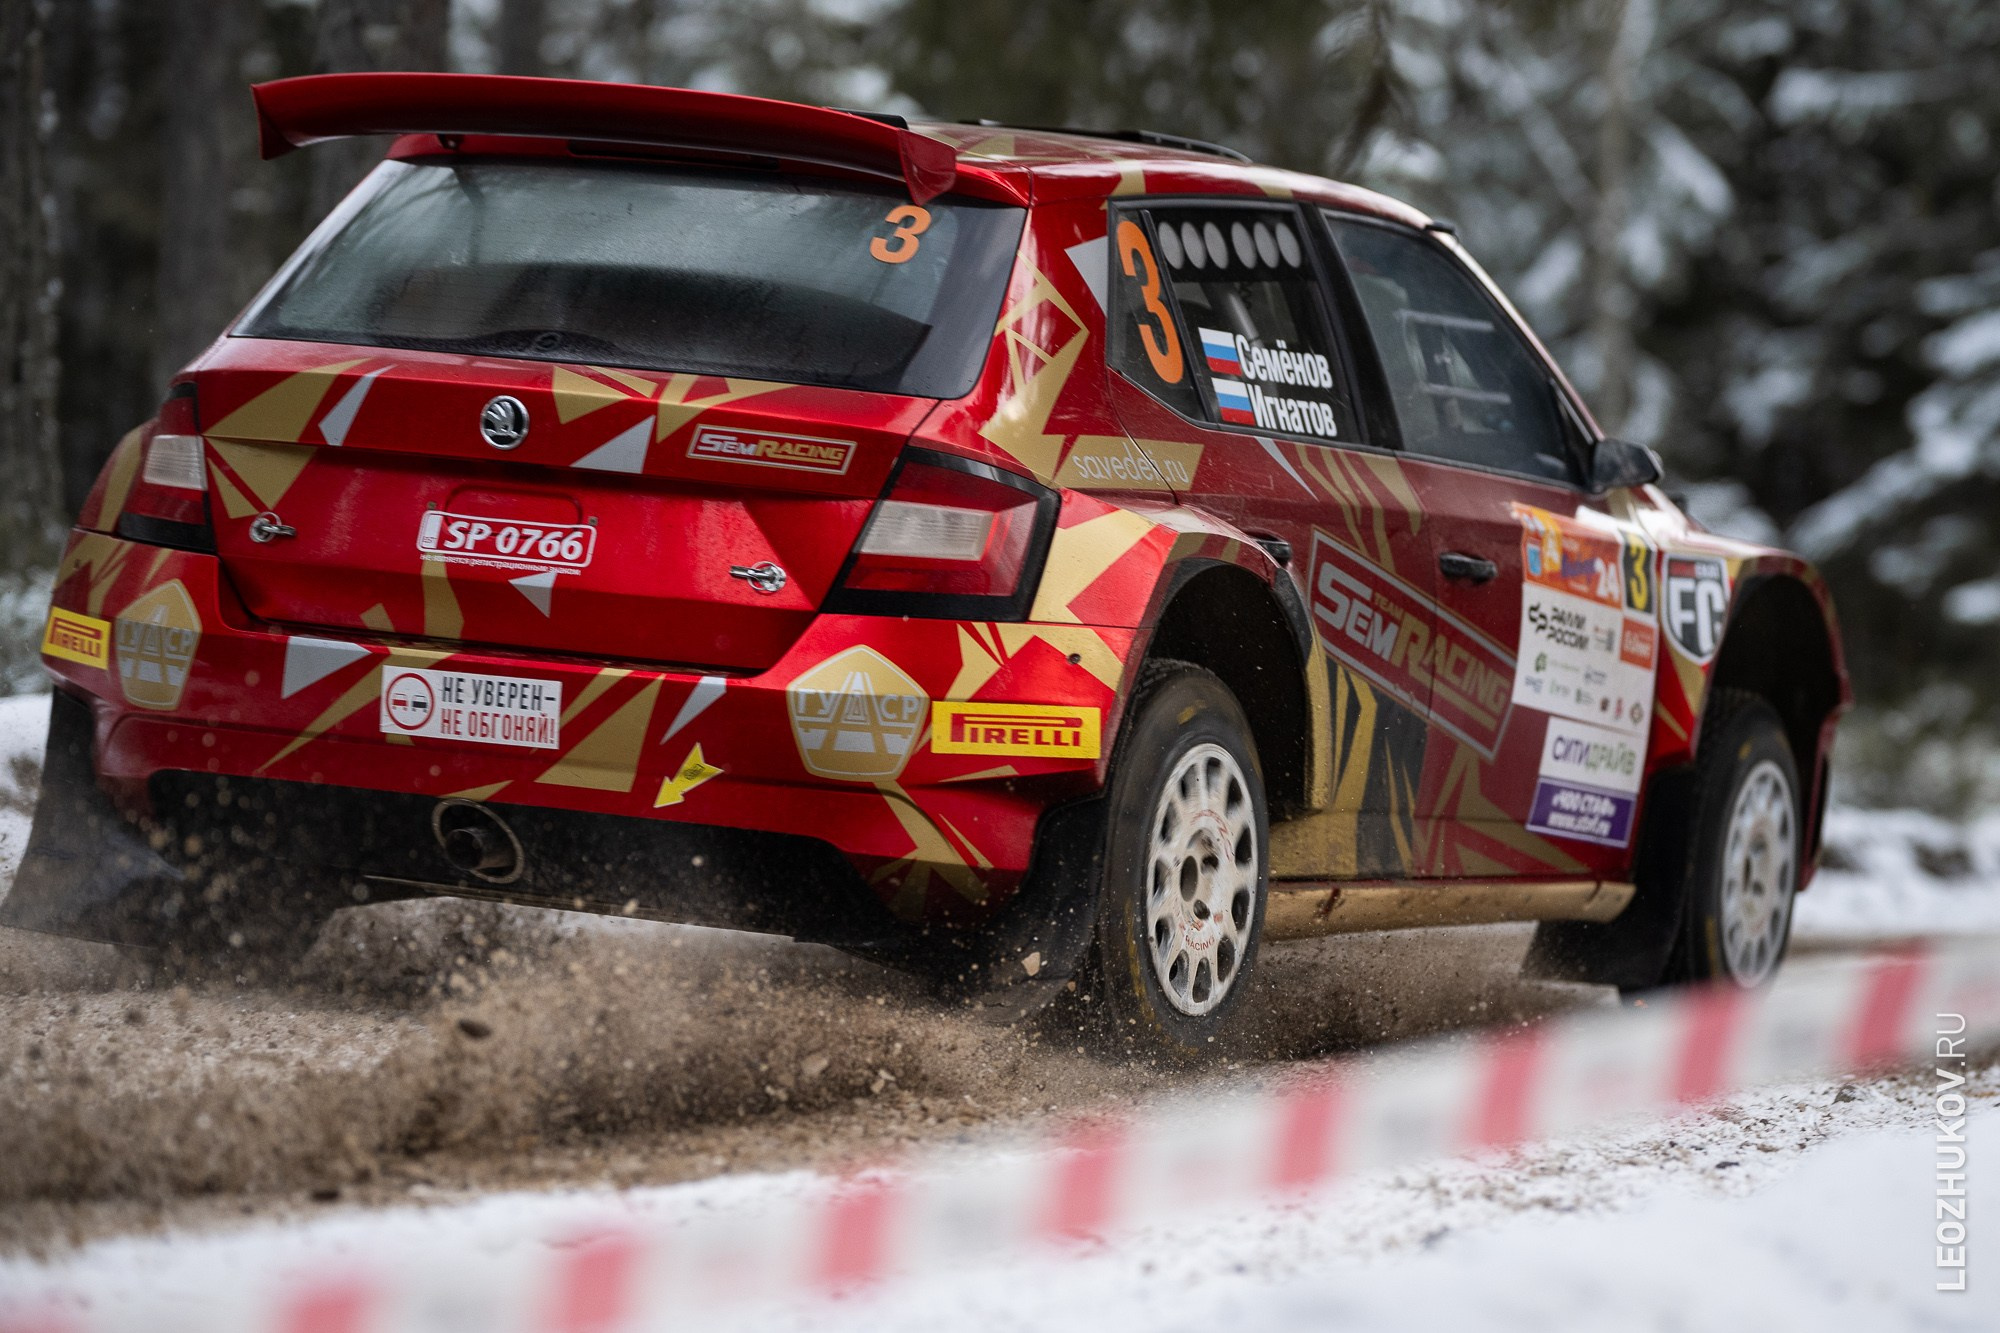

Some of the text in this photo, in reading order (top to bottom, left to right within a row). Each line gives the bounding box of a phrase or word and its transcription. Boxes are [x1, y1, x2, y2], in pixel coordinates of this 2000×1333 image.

[869, 205, 932, 264] 3
[1117, 220, 1184, 384] 3
[1235, 333, 1333, 389] Семёнов
[1246, 383, 1337, 437] Игнатов
[443, 521, 584, 561] SP 0766
[1629, 534, 1649, 611] 3
[441, 676, 466, 704] НЕ
[440, 708, 556, 745] НЕ ОБГОНЯЙ!
[950, 712, 1084, 748] PIRELLI
